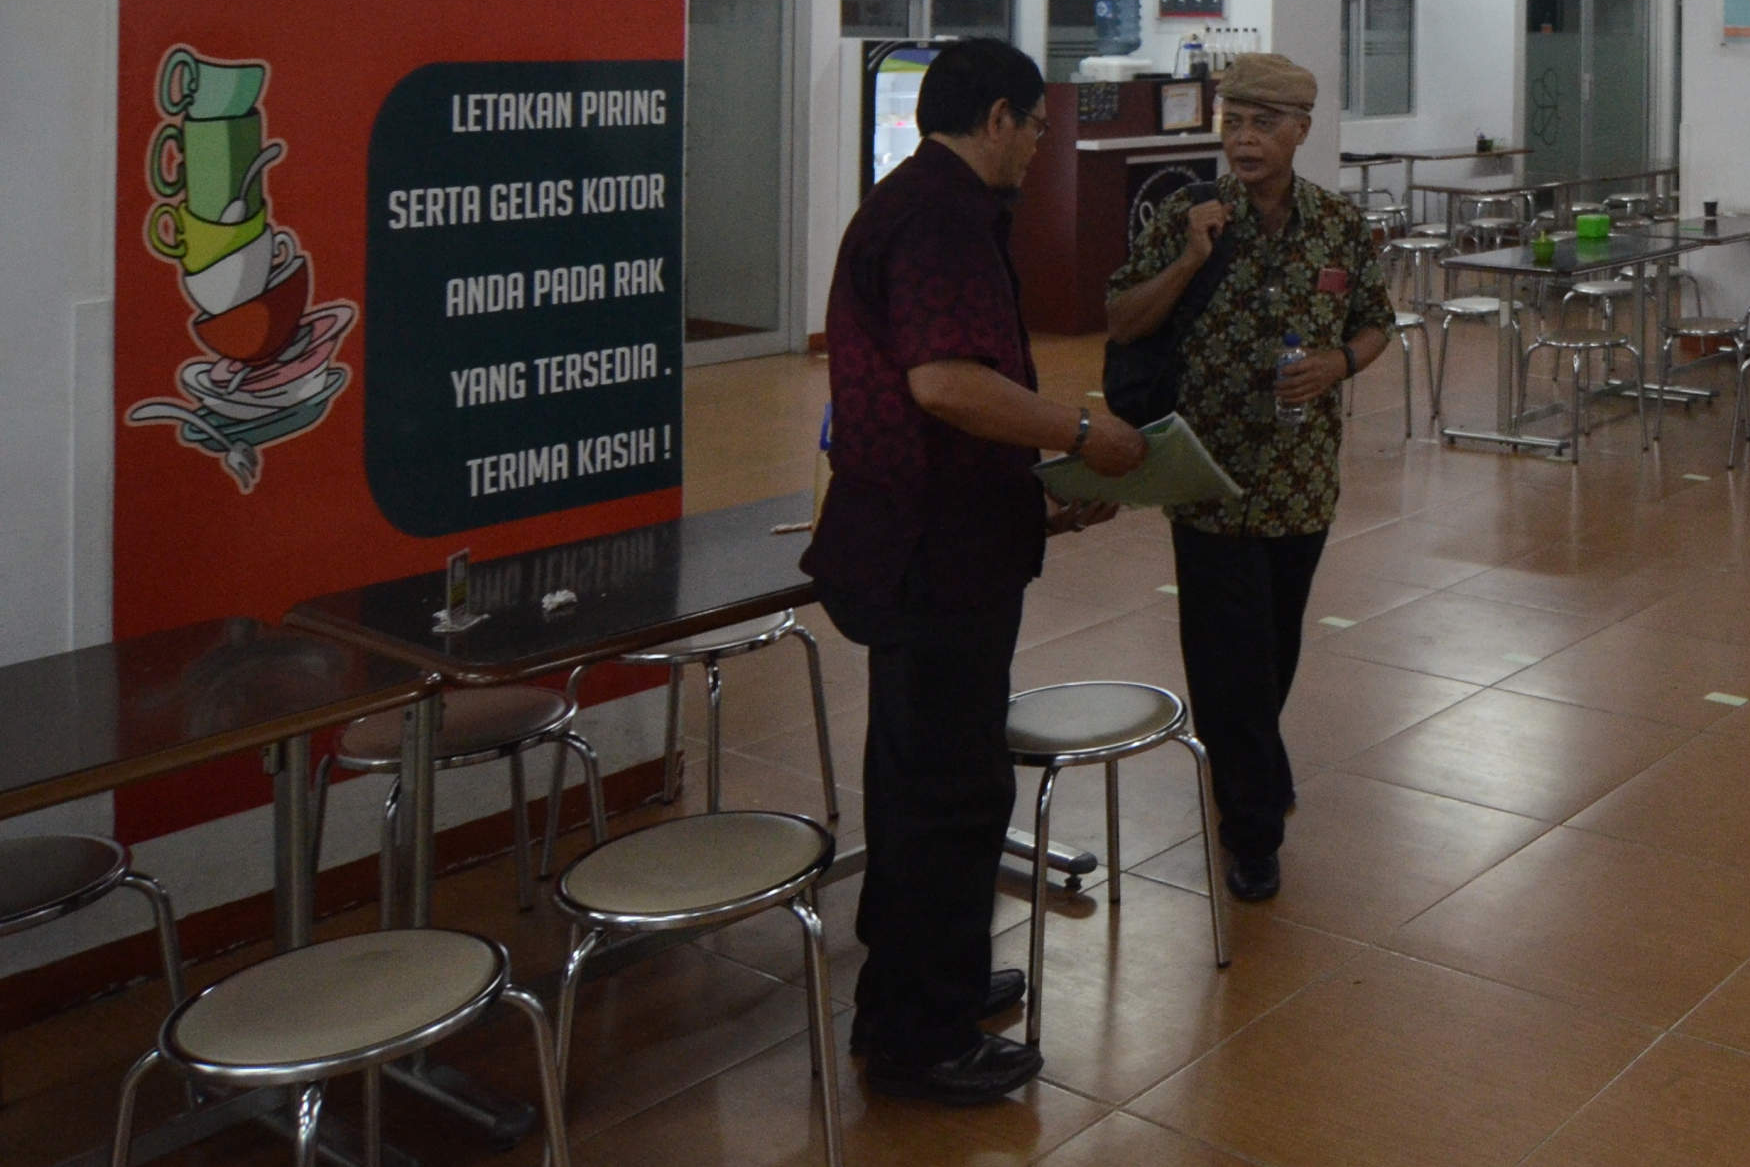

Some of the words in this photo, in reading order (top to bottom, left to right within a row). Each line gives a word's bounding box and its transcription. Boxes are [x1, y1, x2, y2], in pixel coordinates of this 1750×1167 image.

[452, 91, 572, 133] LETAKAN
[581, 89, 667, 128] PIRING
[389, 185, 481, 230] SERTA
[489, 179, 573, 222] GELAS
[581, 173, 665, 215] KOTOR
[446, 271, 525, 318] ANDA
[533, 263, 606, 308] PADA
[614, 257, 665, 298] RAK
[451, 361, 527, 409] YANG
[534, 342, 657, 396] TERSEDIA
[465, 443, 569, 498] TERIMA
[577, 427, 655, 477] KASIH
